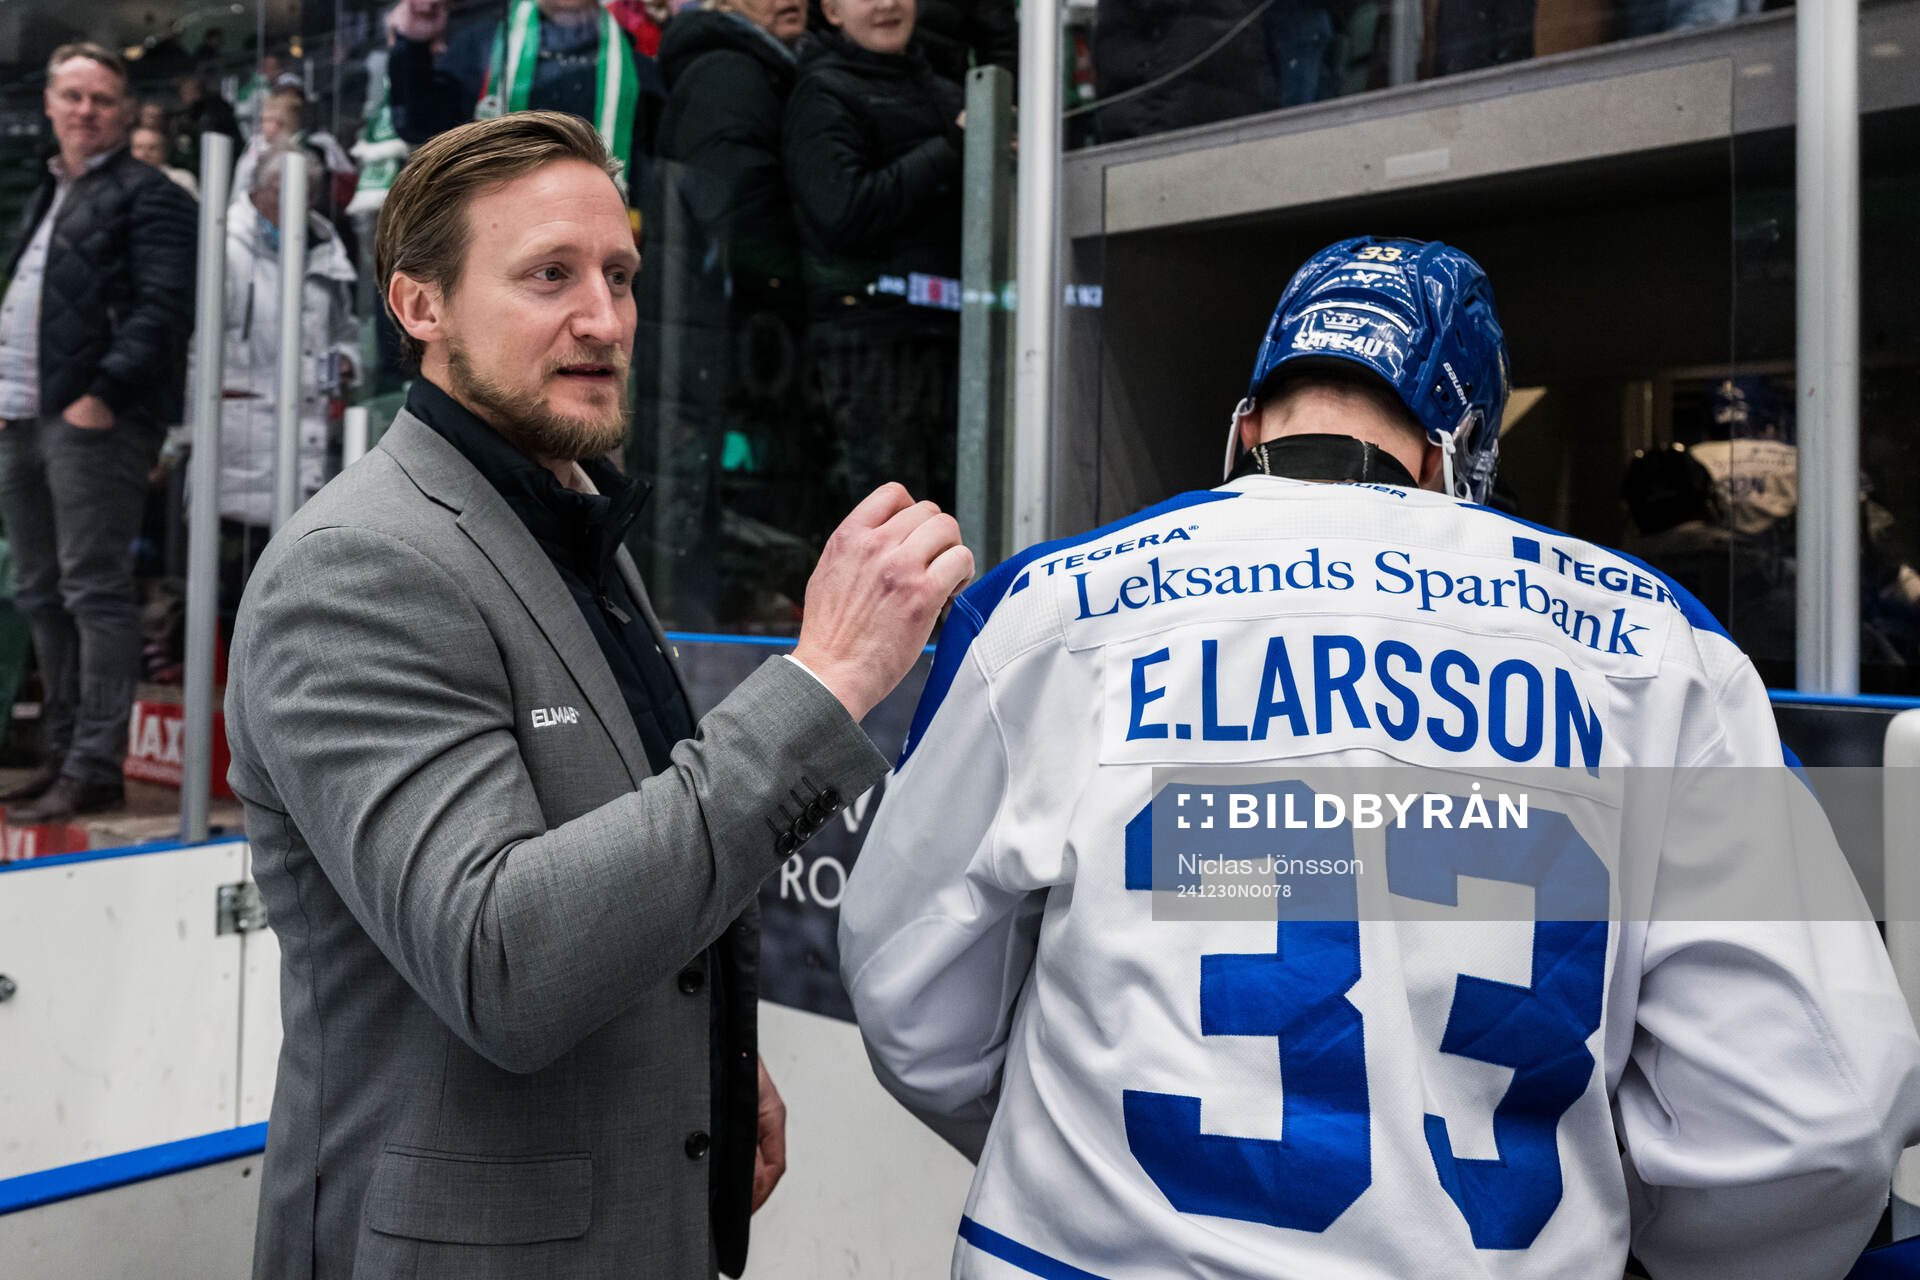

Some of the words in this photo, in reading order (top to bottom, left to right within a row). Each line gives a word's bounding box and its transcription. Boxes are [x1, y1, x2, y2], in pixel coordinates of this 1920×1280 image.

[1357, 246, 1402, 263] 33
[1073, 547, 1354, 621] Leksands
[1375, 551, 1651, 657] Sparbank
[1552, 547, 1682, 611] TEGER
[1126, 635, 1604, 779] E.LARSSON
[1123, 779, 1611, 1250] 33
